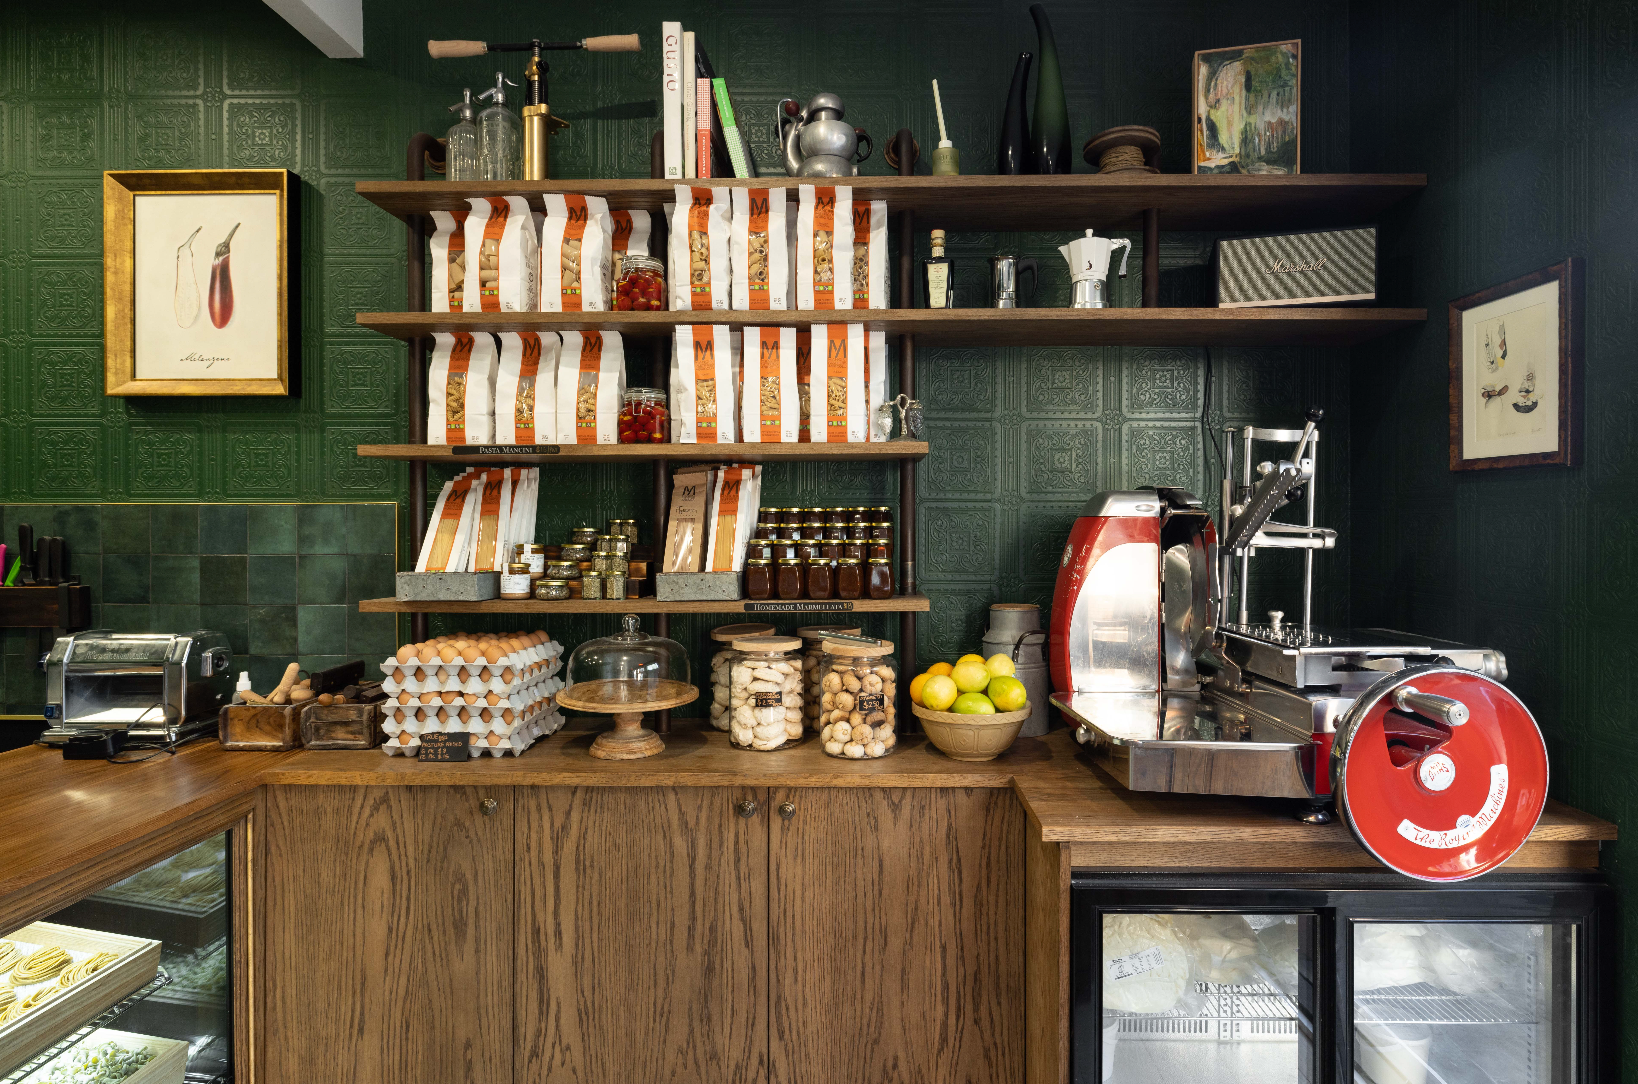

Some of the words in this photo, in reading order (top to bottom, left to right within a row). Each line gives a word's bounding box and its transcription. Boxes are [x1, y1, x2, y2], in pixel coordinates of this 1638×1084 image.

[665, 35, 679, 92] GUSTO
[1265, 258, 1327, 274] Marshall
[479, 446, 500, 454] PASTA
[502, 446, 533, 454] MANCINI
[1413, 827, 1435, 845] The
